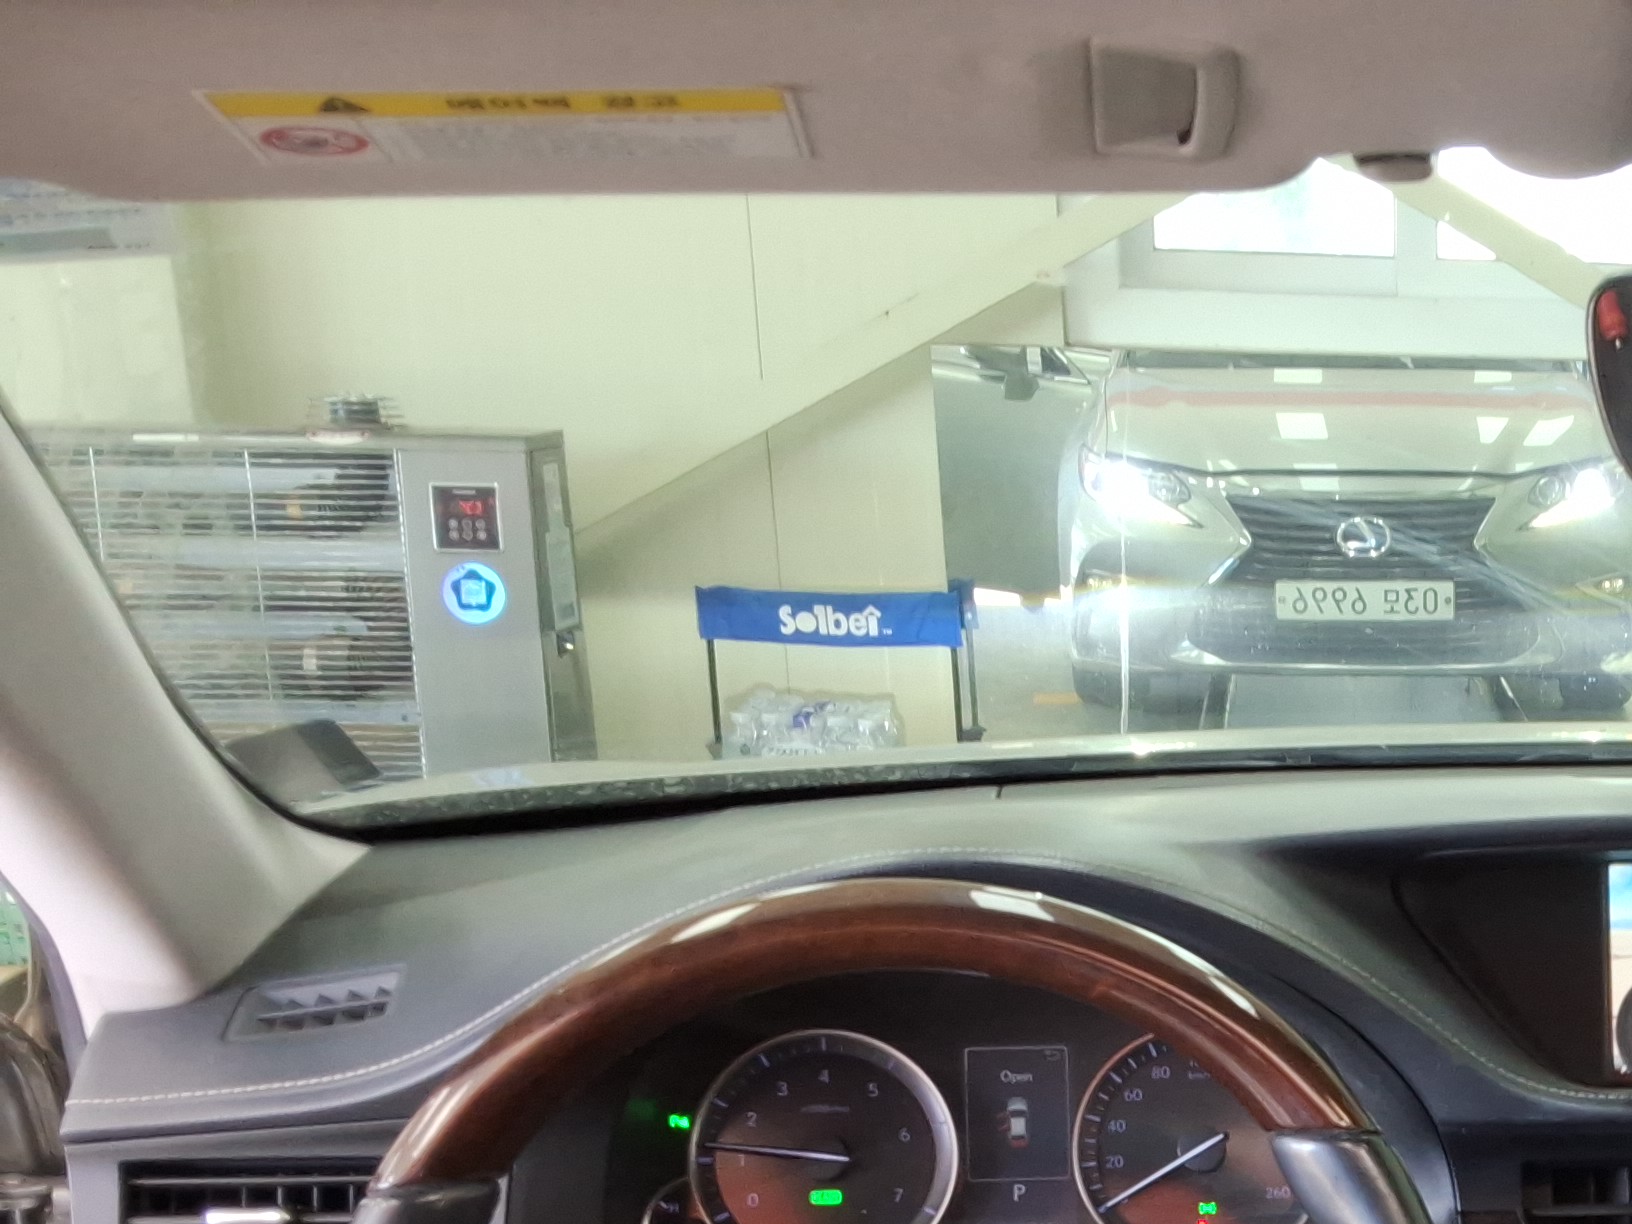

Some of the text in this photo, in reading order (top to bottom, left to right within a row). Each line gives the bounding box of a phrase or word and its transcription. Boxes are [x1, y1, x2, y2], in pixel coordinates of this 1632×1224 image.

[818, 1069, 830, 1084] 4
[1000, 1070, 1033, 1084] Open
[1152, 1065, 1171, 1079] 80
[776, 1081, 789, 1096] 3
[868, 1082, 879, 1097] 5
[1125, 1088, 1143, 1101] 60
[747, 1111, 758, 1127] 2
[1108, 1119, 1127, 1133] 40
[900, 1128, 911, 1142] 6
[1106, 1155, 1125, 1168] 20
[1013, 1184, 1026, 1201] P
[1265, 1186, 1290, 1199] 260
